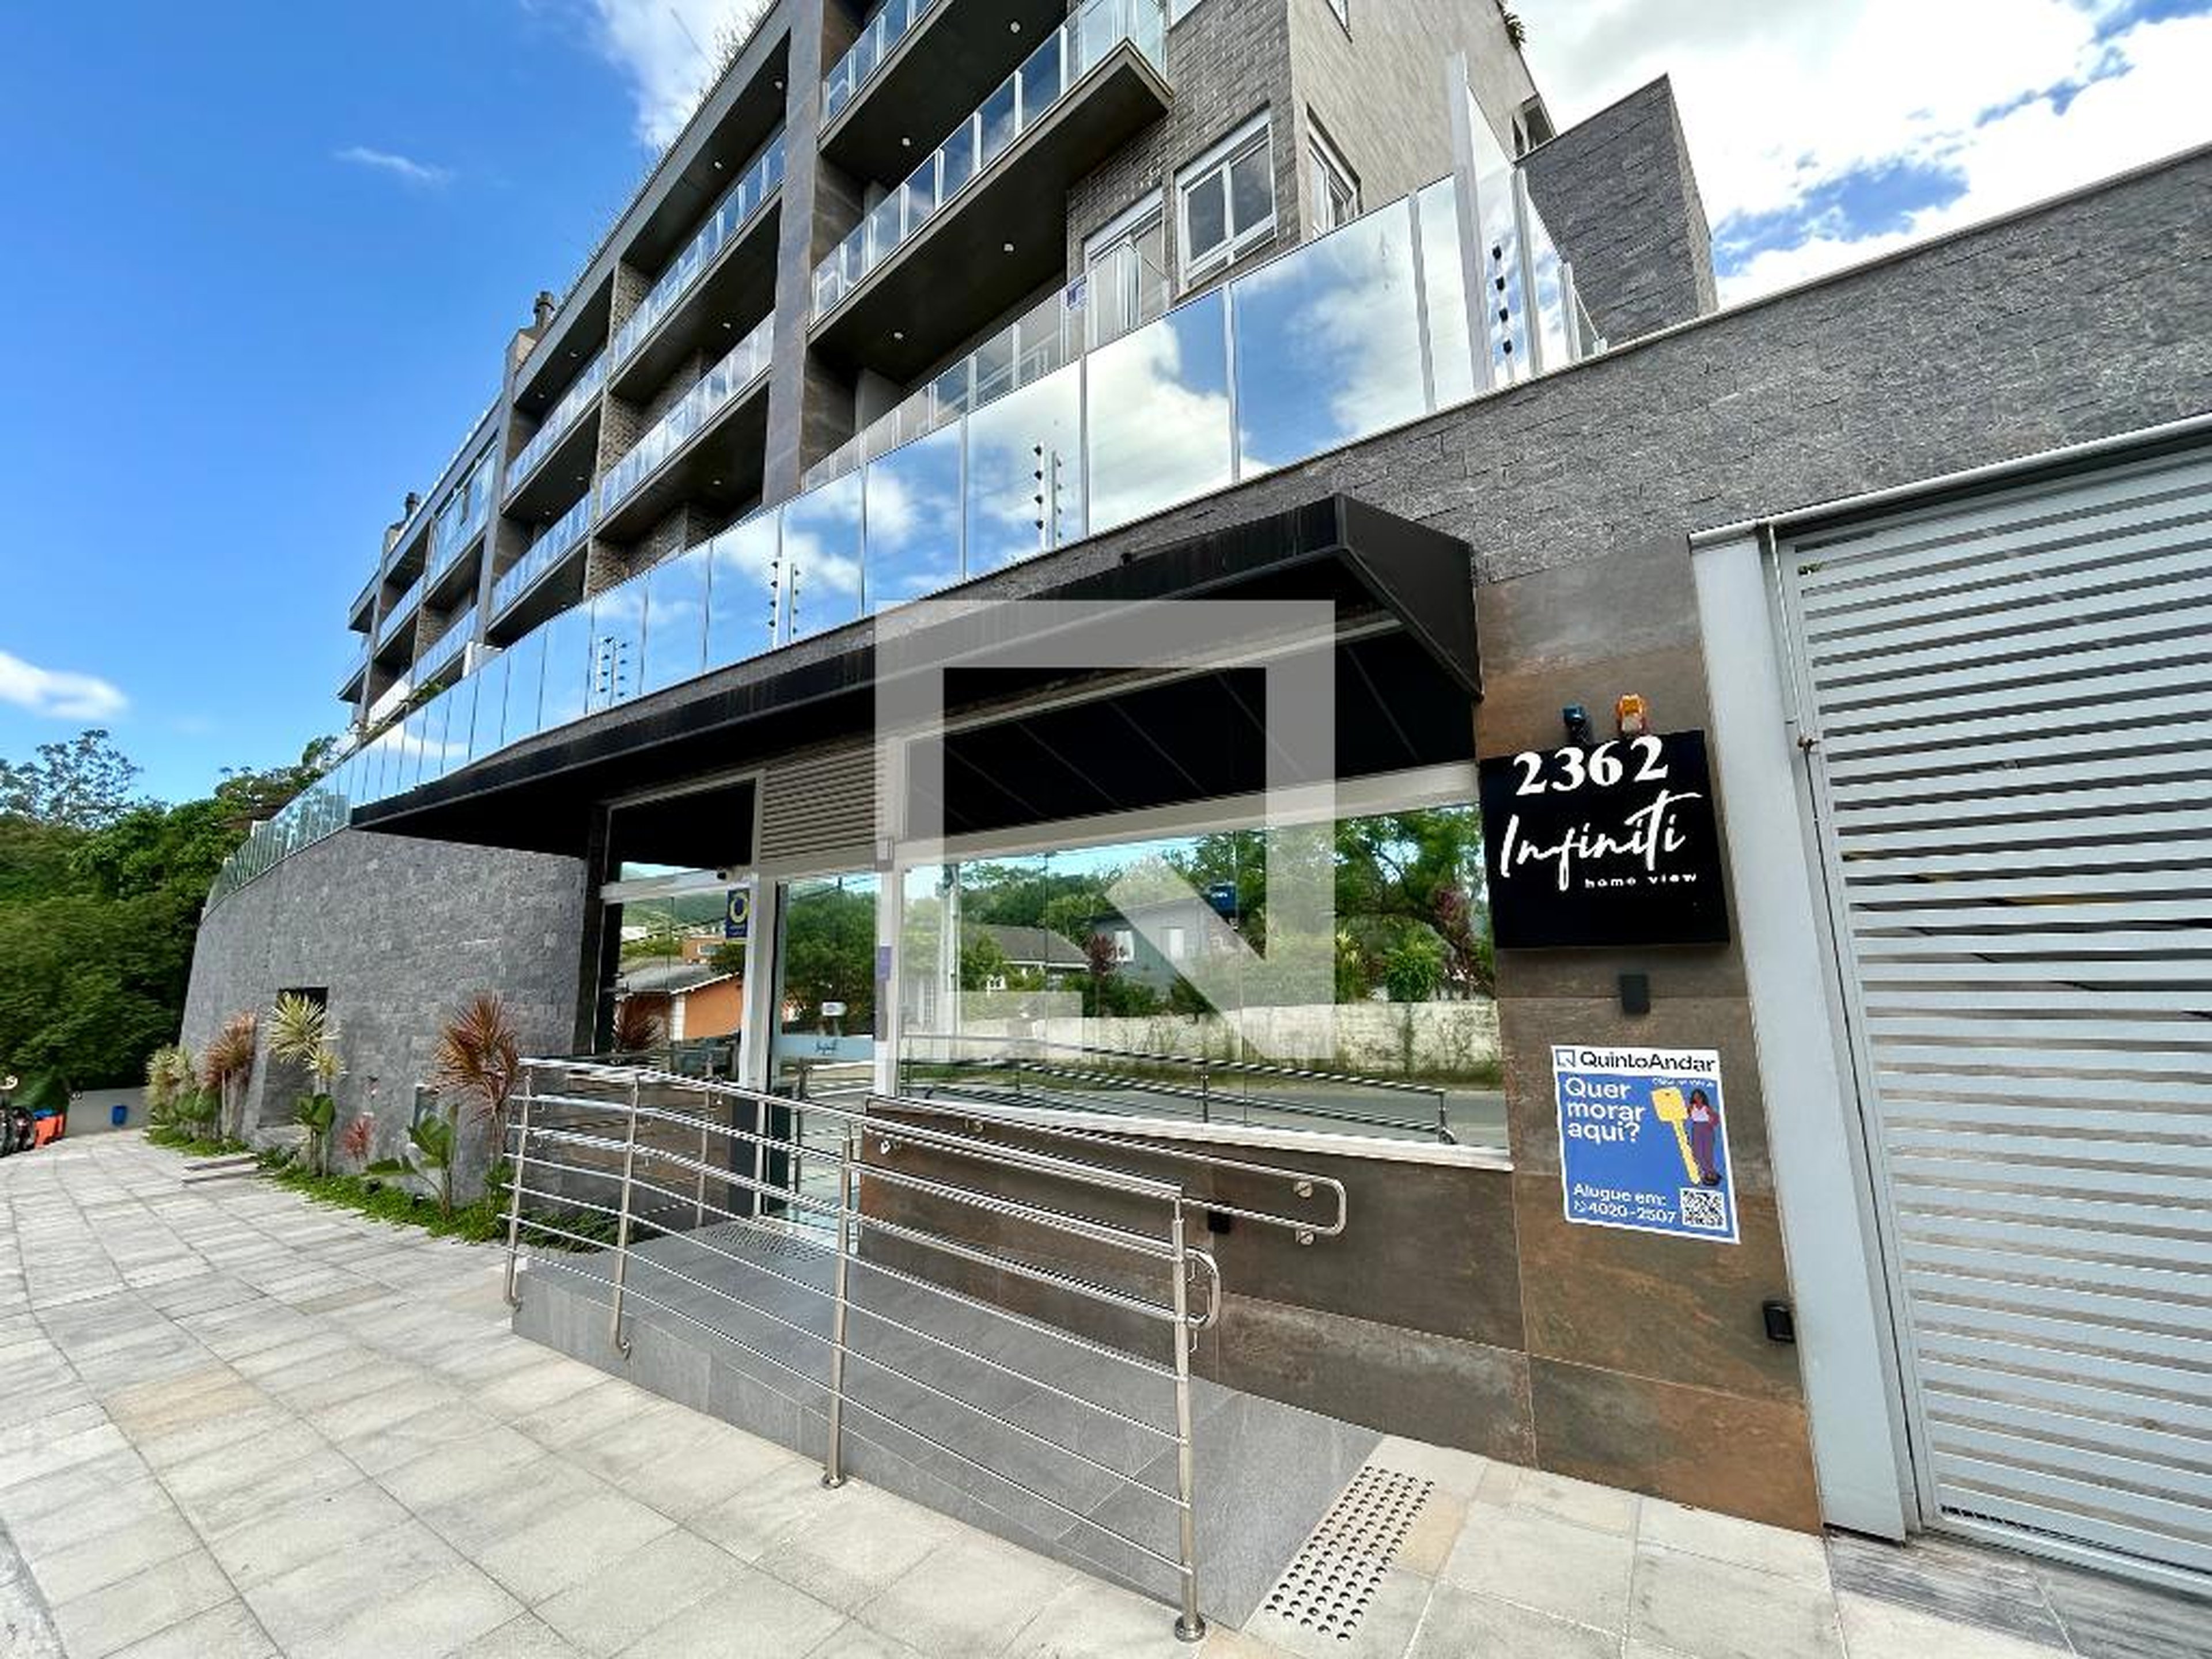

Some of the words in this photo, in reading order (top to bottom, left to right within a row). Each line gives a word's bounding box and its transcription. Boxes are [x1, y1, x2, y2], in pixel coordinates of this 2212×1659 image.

[1513, 734, 1669, 796] 2362
[1500, 789, 1703, 891] Infiniti
[1584, 876, 1637, 888] home
[1647, 872, 1697, 885] view
[1580, 1051, 1715, 1071] QuintoAndar
[1565, 1077, 1630, 1100] Quer
[1566, 1101, 1646, 1122] morar
[1567, 1121, 1641, 1145] aqui?
[1573, 1183, 1632, 1202] Alugue
[1635, 1192, 1666, 1206] em:
